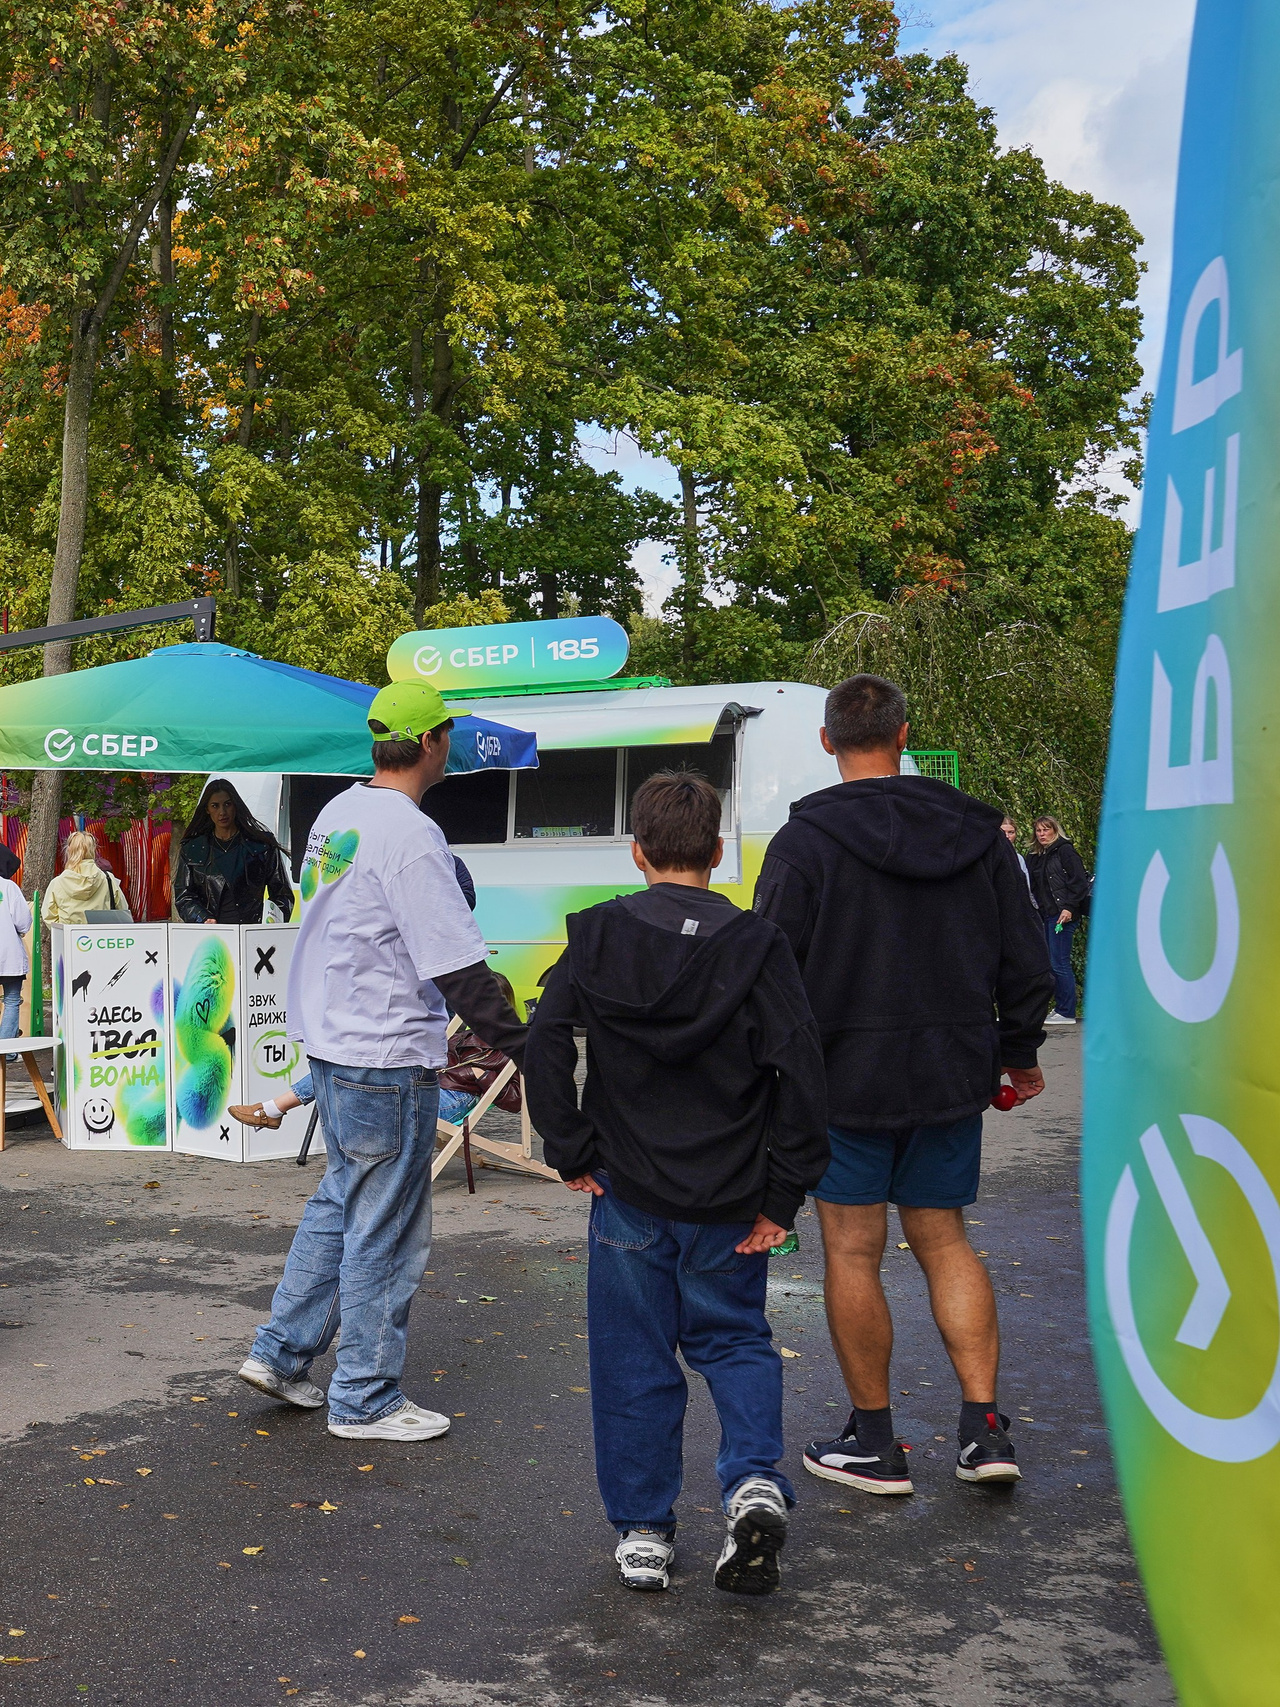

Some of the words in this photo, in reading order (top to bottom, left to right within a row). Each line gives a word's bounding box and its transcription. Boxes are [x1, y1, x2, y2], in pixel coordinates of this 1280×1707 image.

[1136, 255, 1243, 1024] СБЕР
[449, 644, 519, 668] СБЕР
[547, 637, 600, 661] 185
[82, 733, 159, 757] СБЕР
[96, 938, 135, 949] СБЕР
[248, 994, 277, 1007] ЗВУК
[87, 1005, 143, 1025] ЗДЕСЬ
[90, 1028, 157, 1060] ТВОЯ
[263, 1044, 286, 1063] ТЫ
[90, 1064, 161, 1088] ВОЛНА
